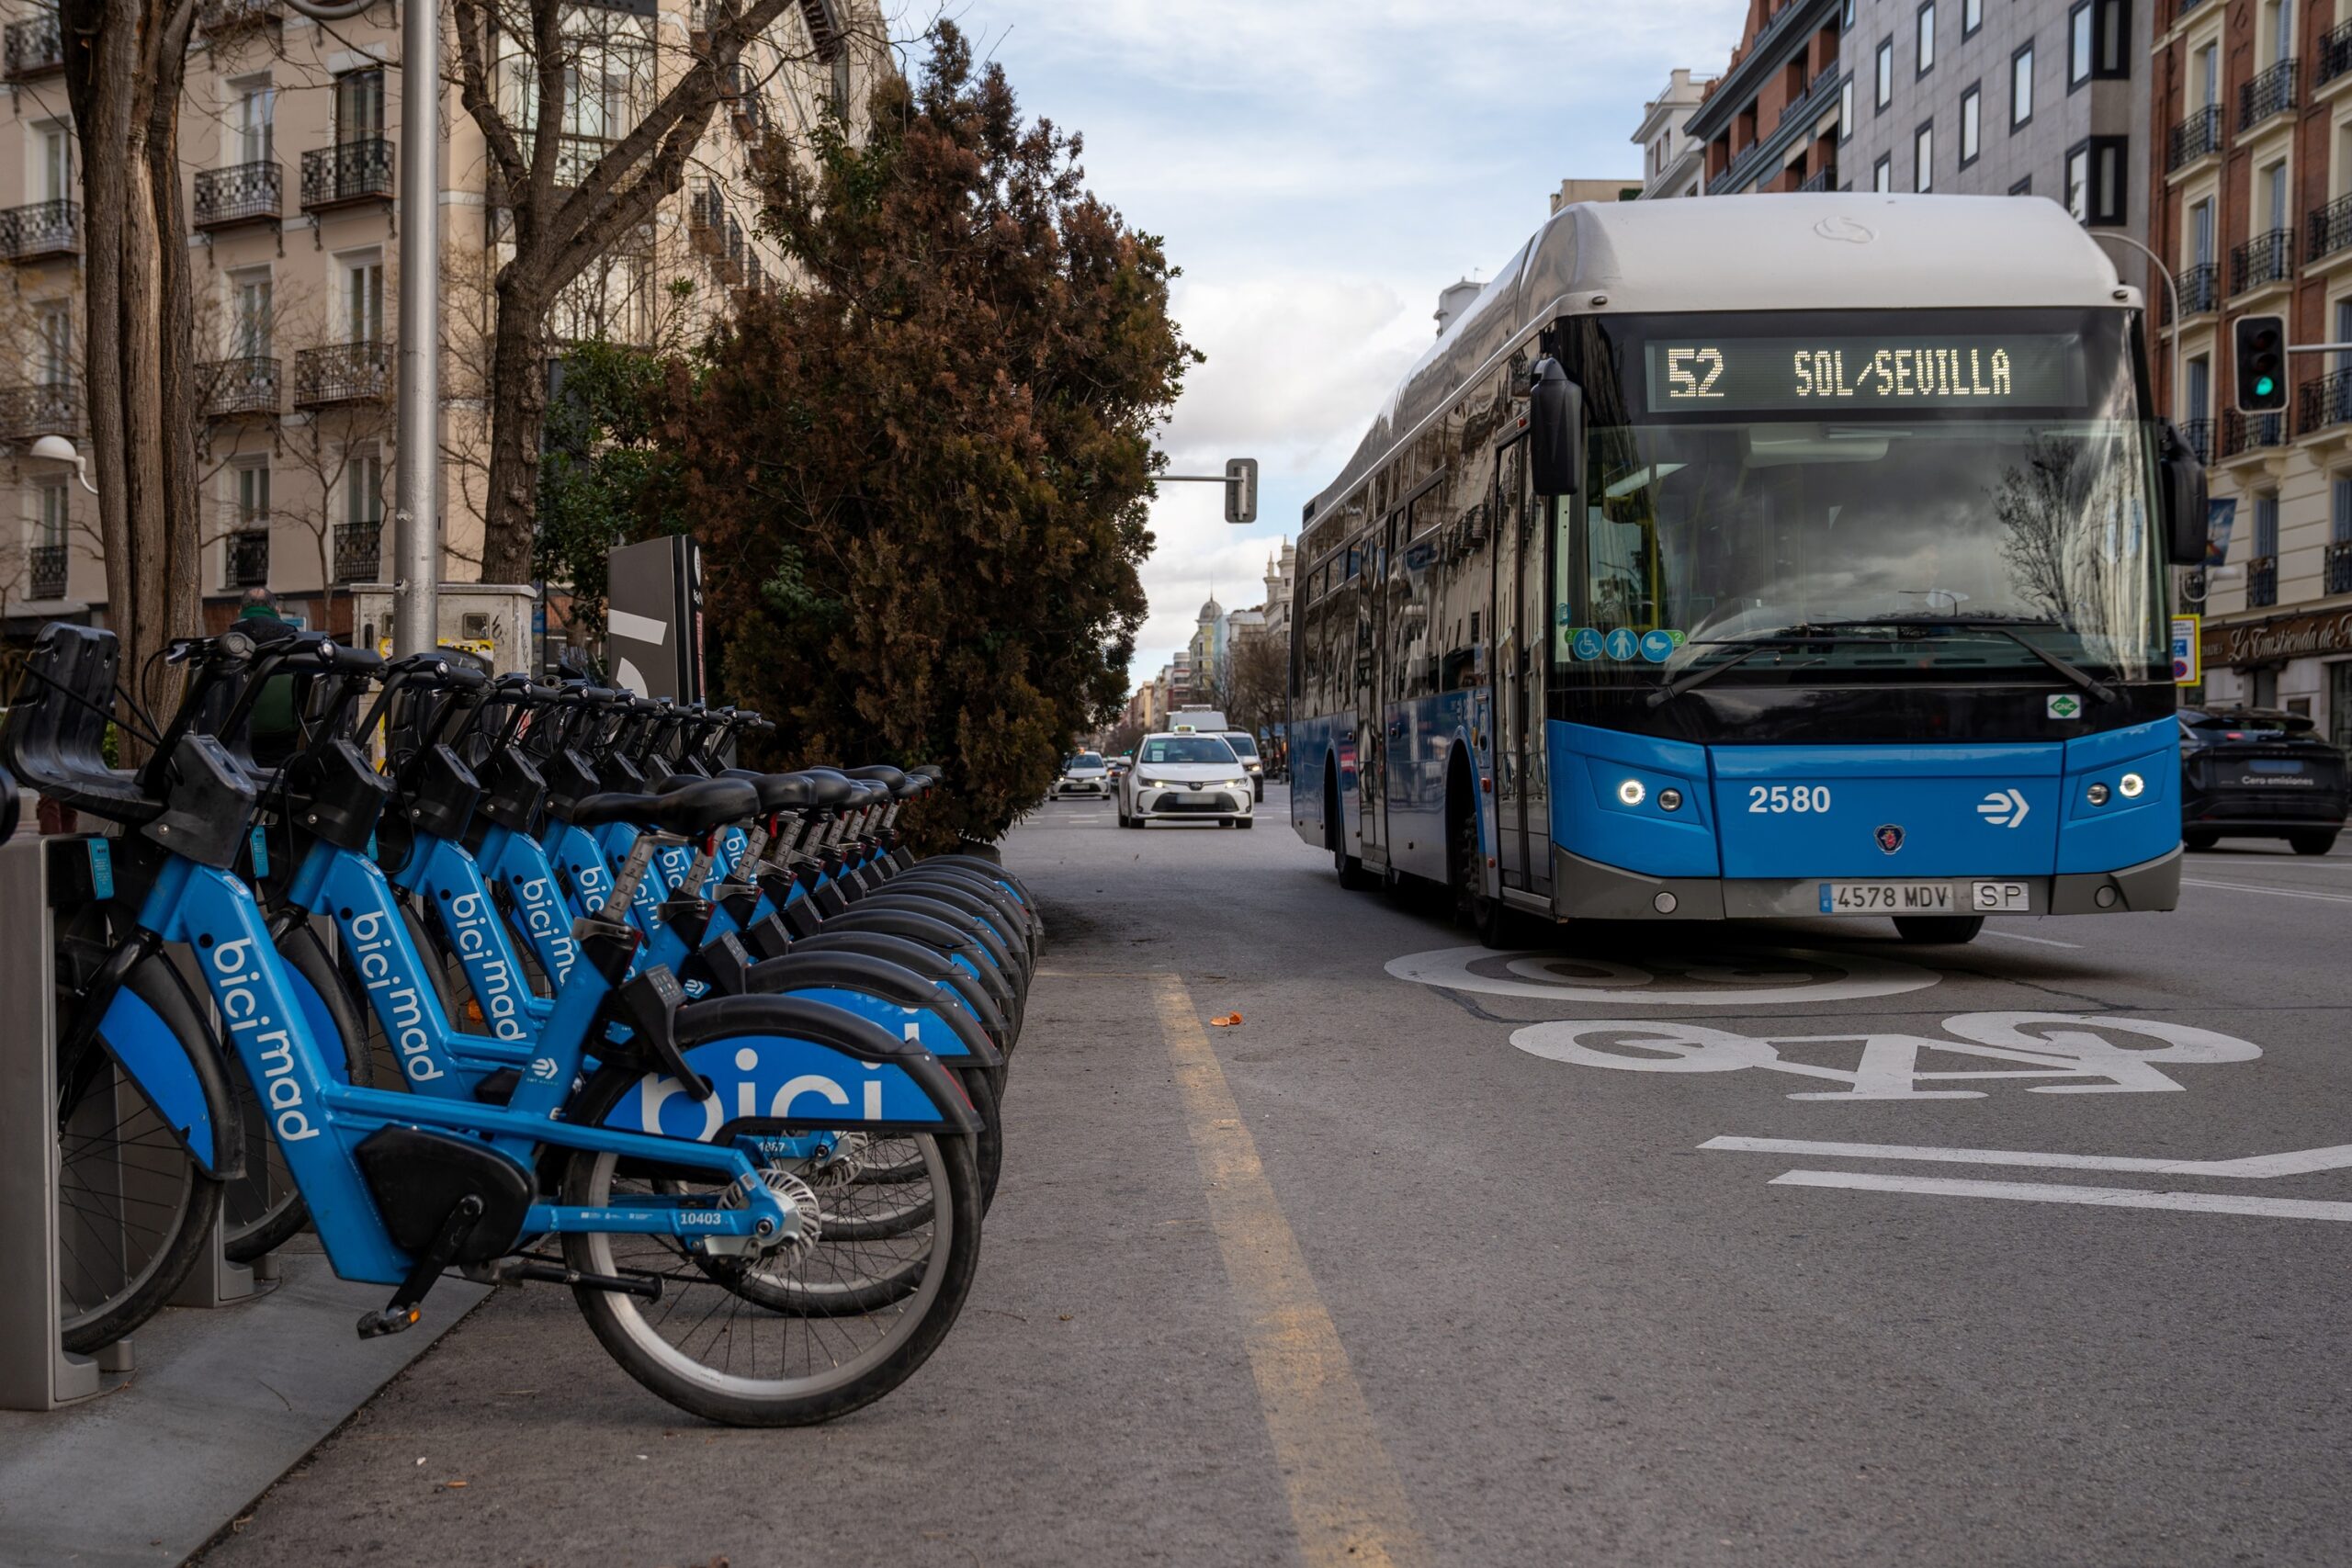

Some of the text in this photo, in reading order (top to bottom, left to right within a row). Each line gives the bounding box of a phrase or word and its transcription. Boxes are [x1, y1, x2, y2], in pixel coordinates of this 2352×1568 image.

[1668, 348, 2011, 397] 52 SOL/SEVILLA
[1674, 632, 1681, 642] 2
[2318, 619, 2335, 649] de
[2053, 702, 2075, 711] GNC
[1748, 785, 1831, 813] 2580
[1838, 886, 1896, 908] 4578
[1905, 886, 1948, 908] MDV
[1980, 886, 2022, 908] SP
[680, 1213, 721, 1225] 10403
